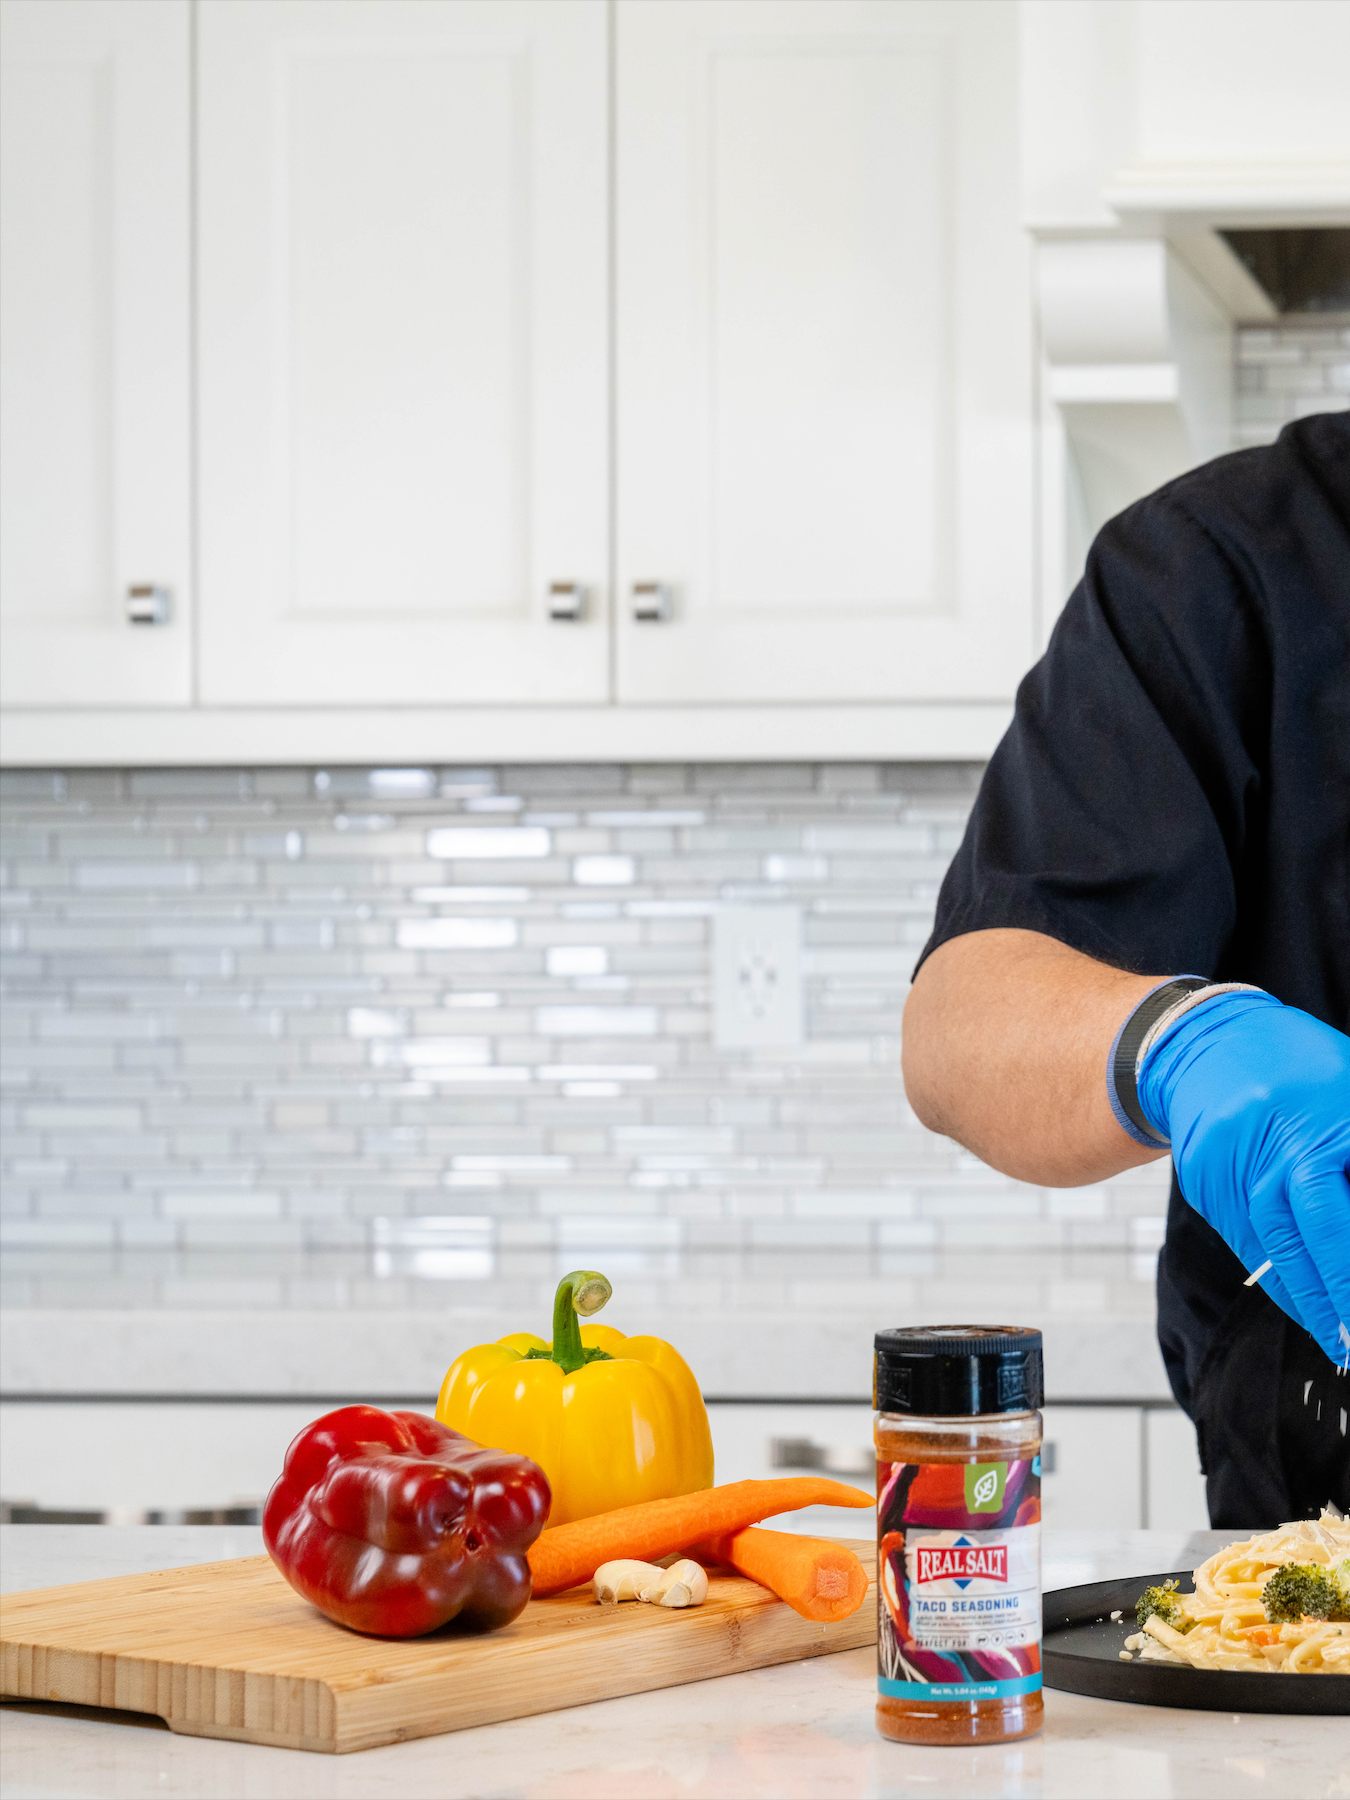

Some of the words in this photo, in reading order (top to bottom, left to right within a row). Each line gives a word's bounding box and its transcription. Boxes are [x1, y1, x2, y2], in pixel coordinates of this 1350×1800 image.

[920, 1550, 965, 1580] REAL
[965, 1549, 1005, 1577] SALT
[916, 1601, 947, 1612] TACO
[952, 1597, 1019, 1612] SEASONING
